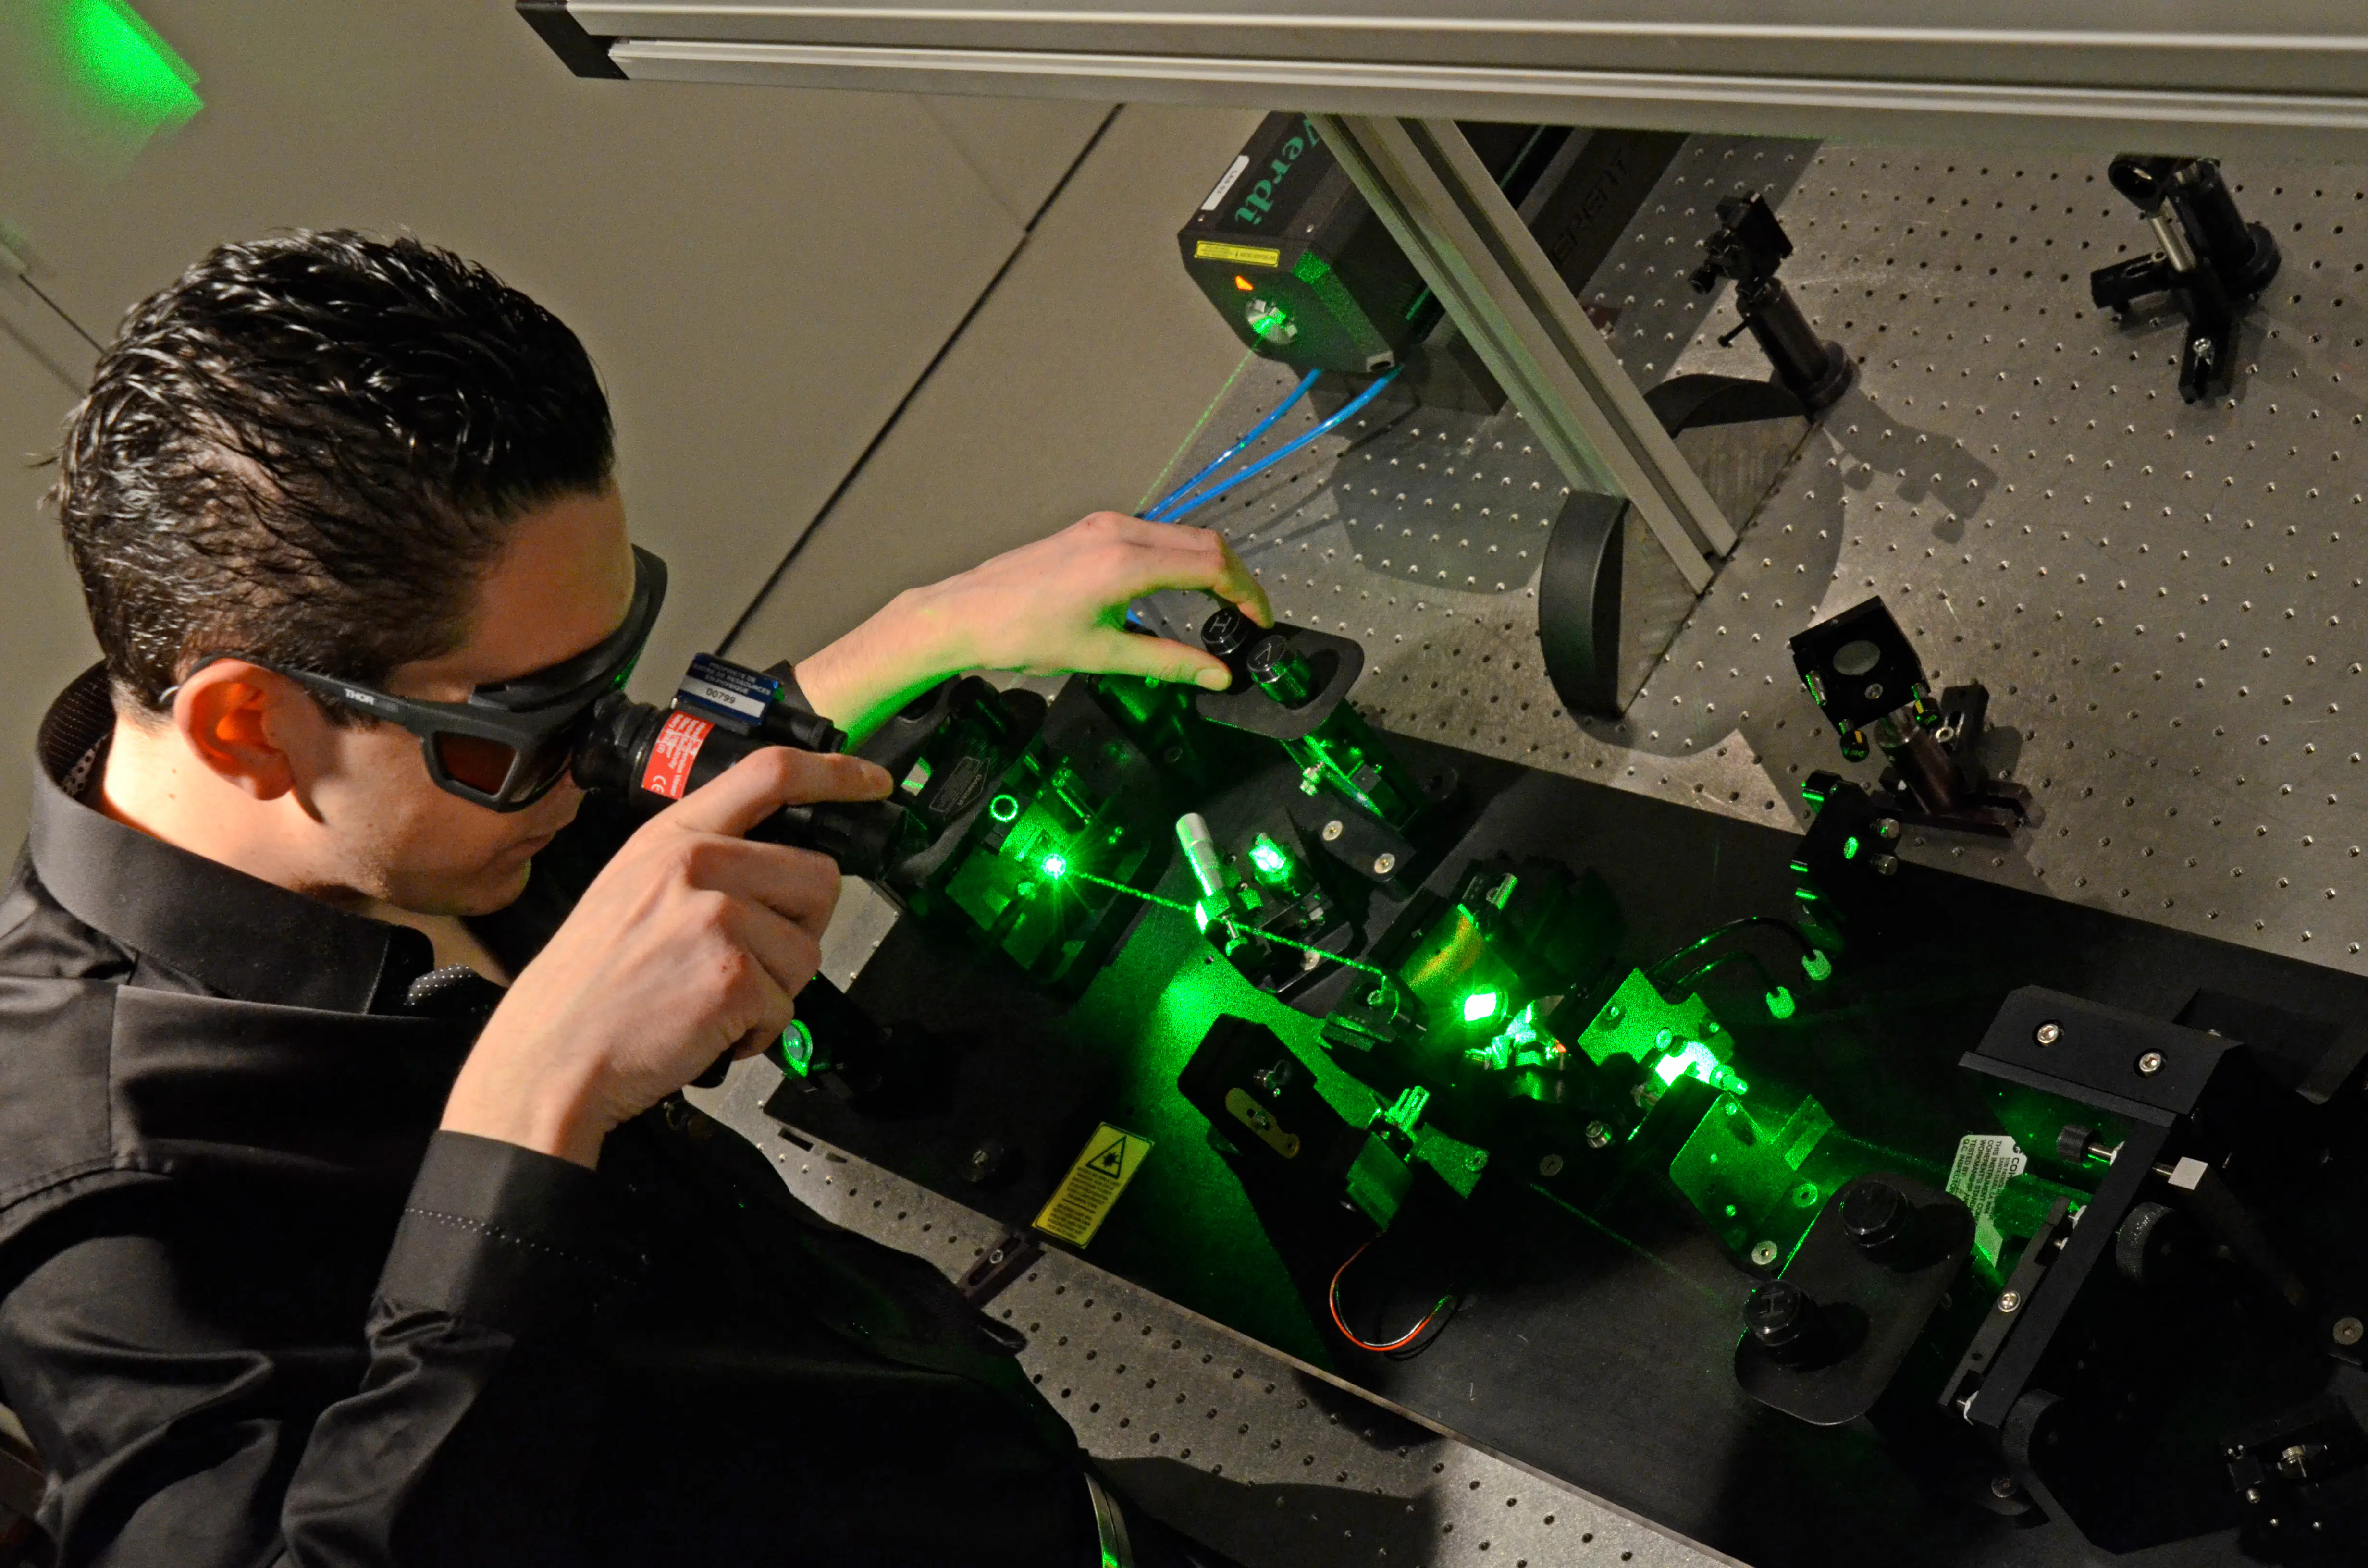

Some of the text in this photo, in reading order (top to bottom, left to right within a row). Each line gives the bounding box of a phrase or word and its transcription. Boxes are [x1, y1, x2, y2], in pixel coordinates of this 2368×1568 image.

[1209, 615, 1233, 633] H
[706, 687, 736, 704] 00799
[651, 774, 667, 793] CE
[1965, 1139, 1977, 1165] TESTED
[1993, 1140, 2002, 1156] THIS
[1967, 1139, 1986, 1192] WORKMANSHIP
[1976, 1139, 1994, 1184] COHERENT'S
[1980, 1157, 1997, 1202] INSTRUMENT
